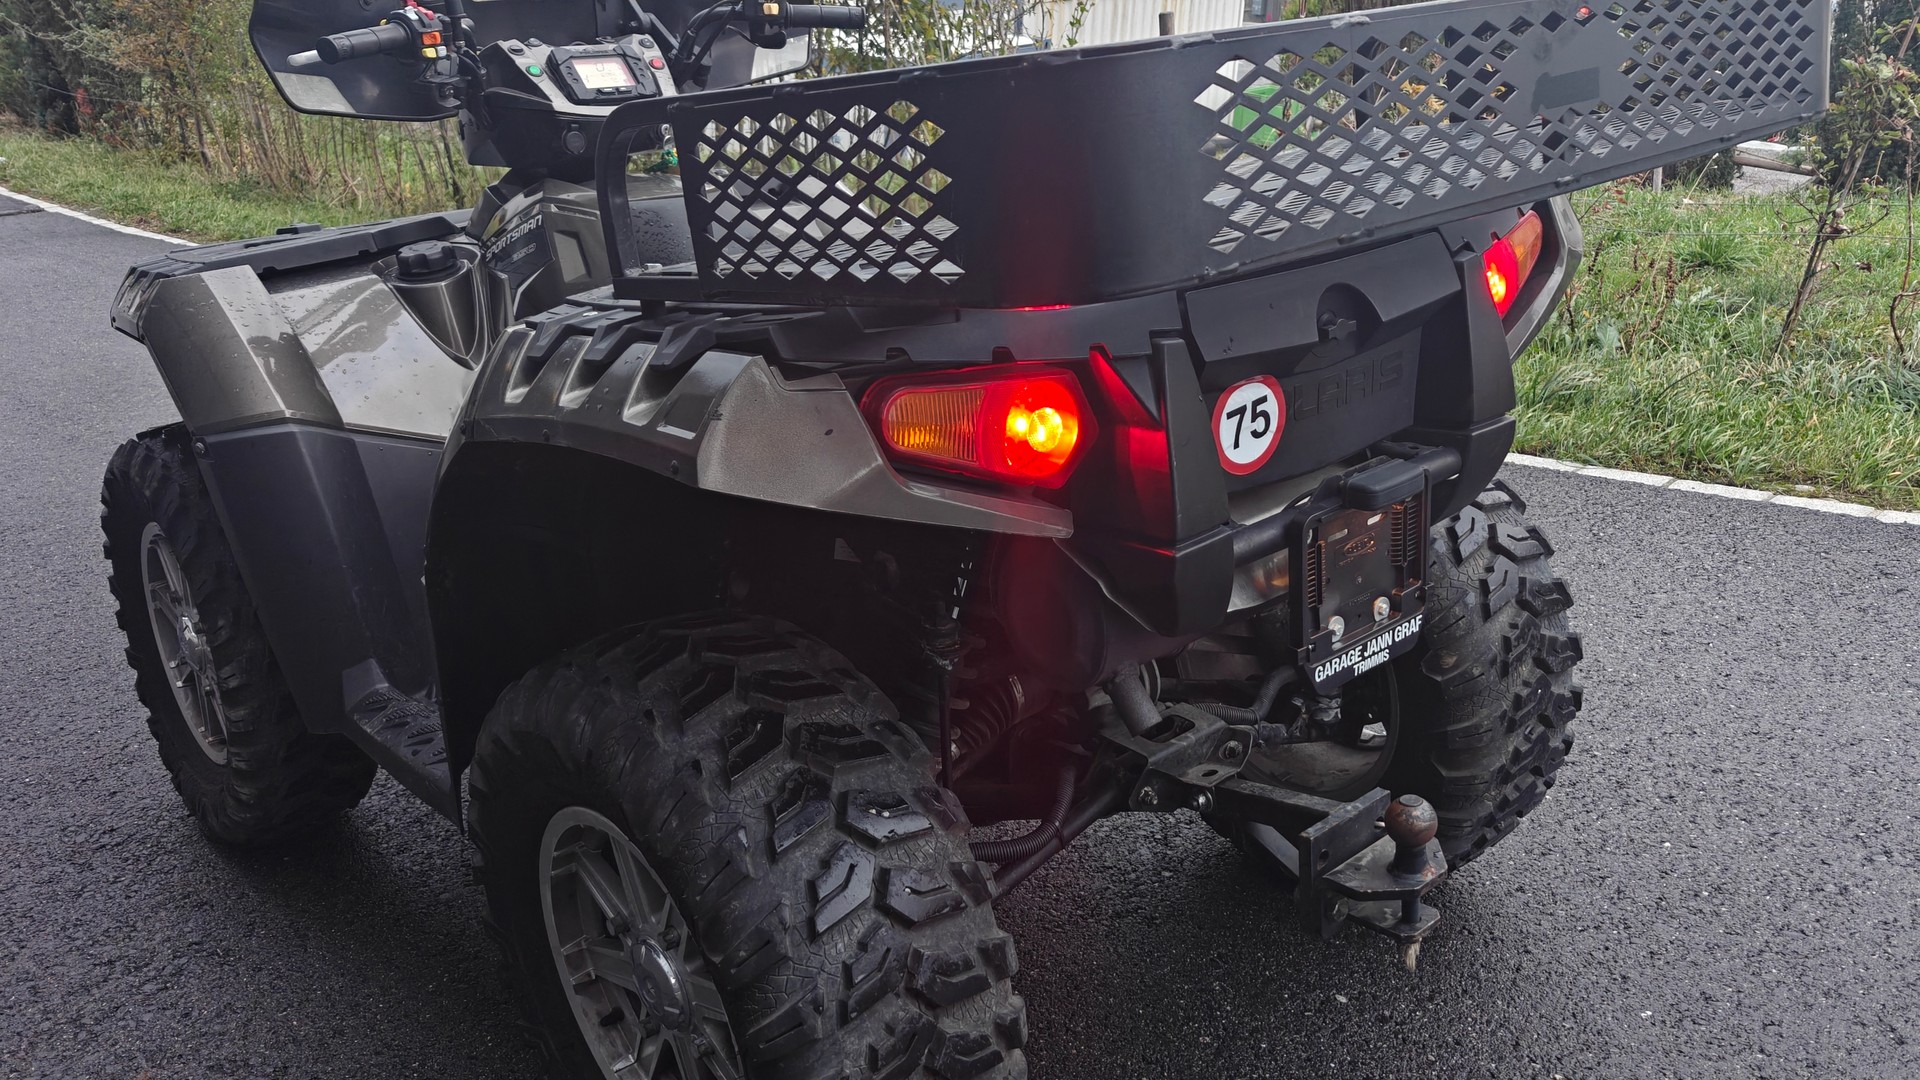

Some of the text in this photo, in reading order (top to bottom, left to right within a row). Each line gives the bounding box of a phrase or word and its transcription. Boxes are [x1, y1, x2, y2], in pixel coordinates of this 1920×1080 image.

[486, 214, 542, 261] SPORTSMAN
[1226, 395, 1270, 450] 75
[1315, 615, 1422, 682] GARAGE JANN GRAF
[1353, 648, 1390, 676] TRIMMIS
